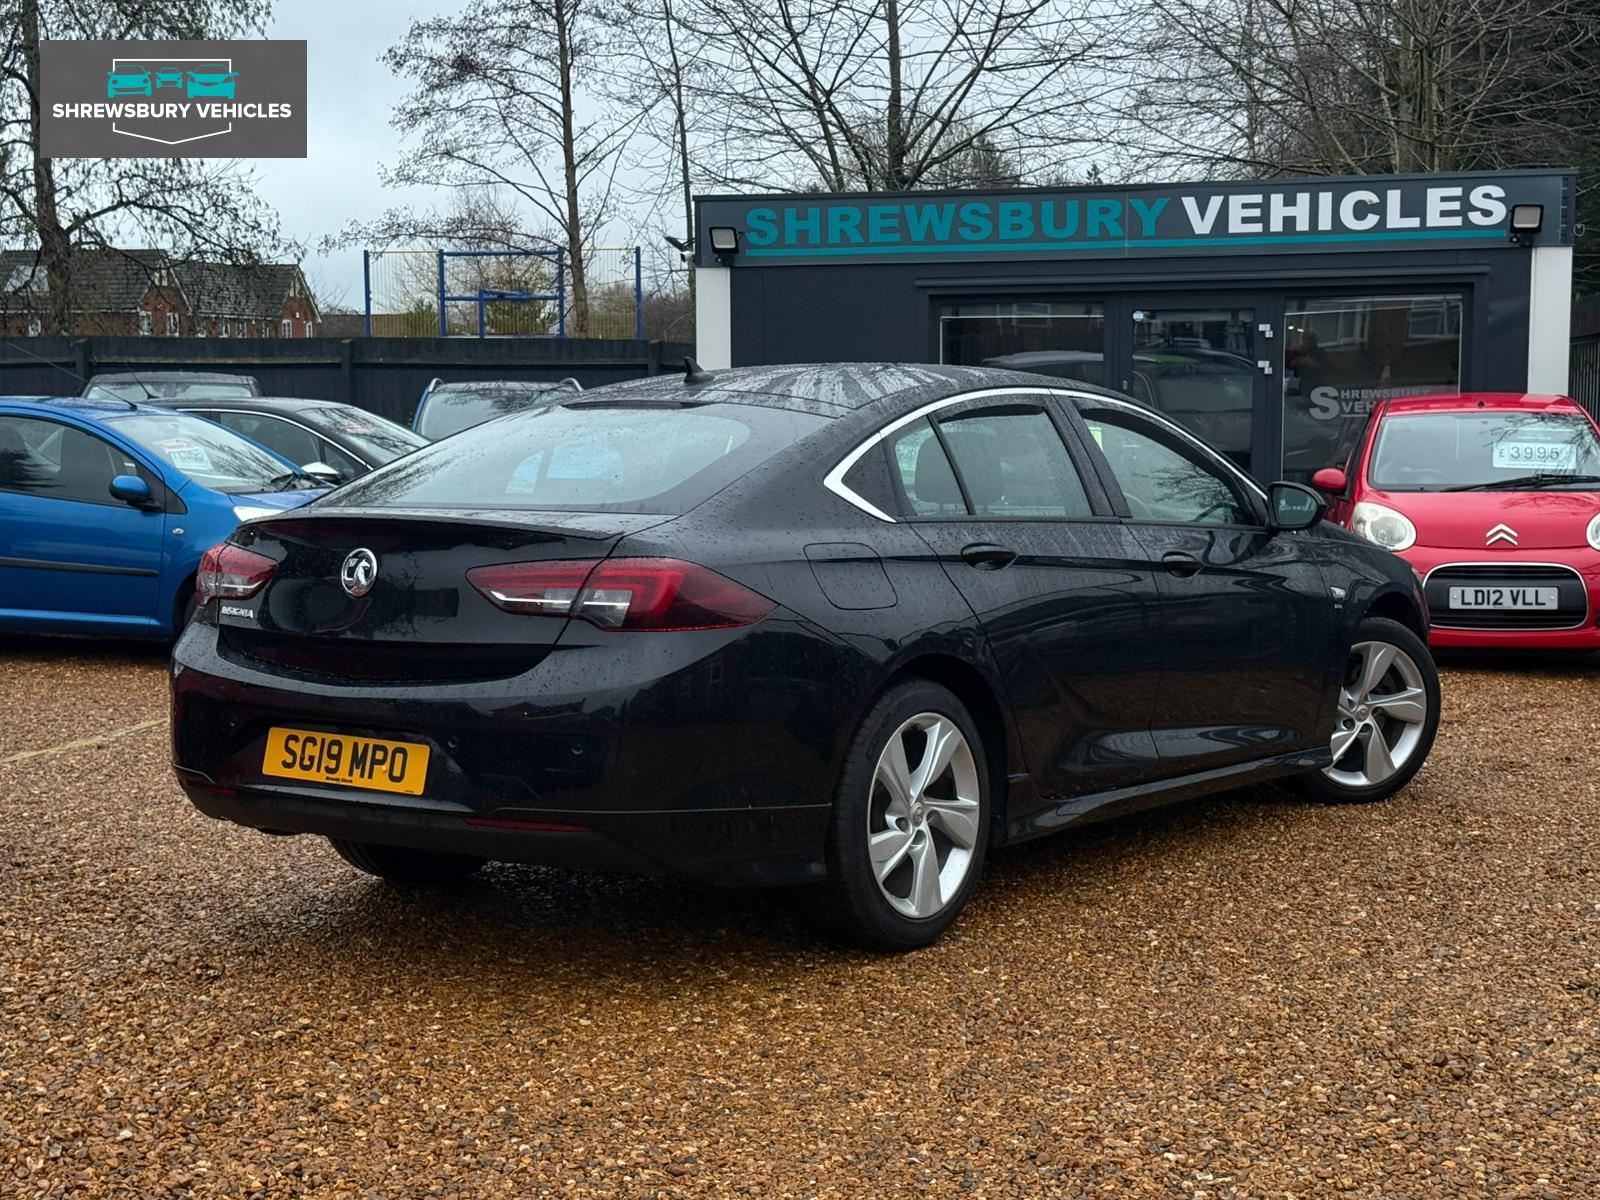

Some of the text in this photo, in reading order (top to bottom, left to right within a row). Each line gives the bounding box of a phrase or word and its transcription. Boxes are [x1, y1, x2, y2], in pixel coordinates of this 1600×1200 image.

[745, 185, 1507, 246] SHREWSBURY VEHICLES
[1461, 589, 1546, 606] LD12 VLL
[281, 734, 409, 784] SG19 MPO
